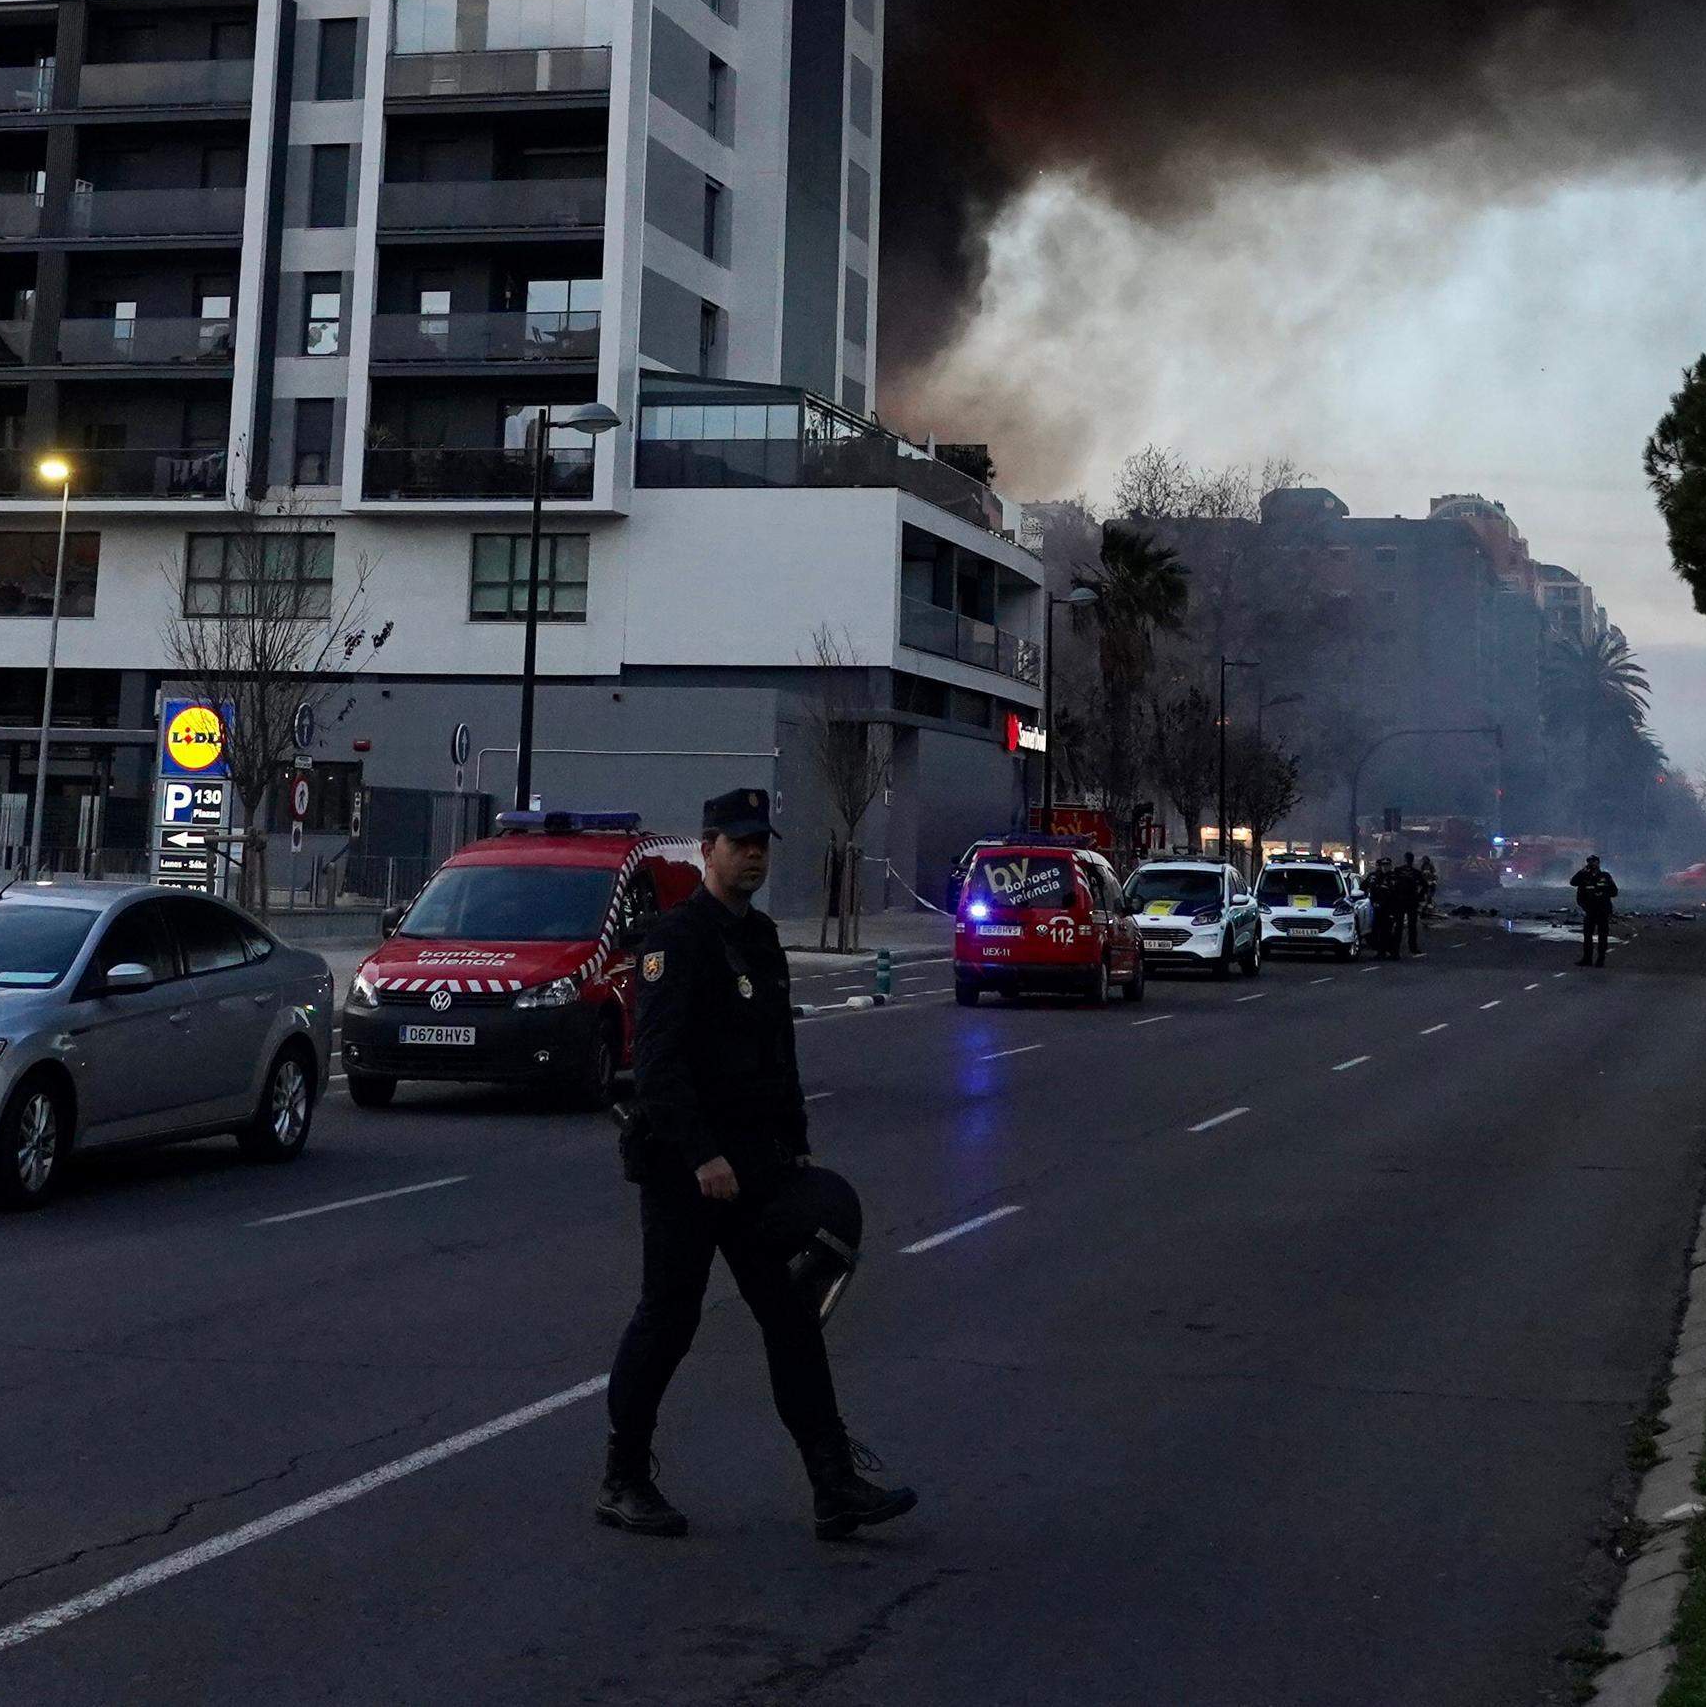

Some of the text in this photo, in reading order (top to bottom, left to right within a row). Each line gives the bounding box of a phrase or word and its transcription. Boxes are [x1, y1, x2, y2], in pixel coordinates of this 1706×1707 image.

[164, 783, 193, 821] P
[194, 789, 222, 805] 130
[1050, 927, 1074, 944] 112
[416, 957, 506, 967] valencia
[417, 950, 516, 959] bombers
